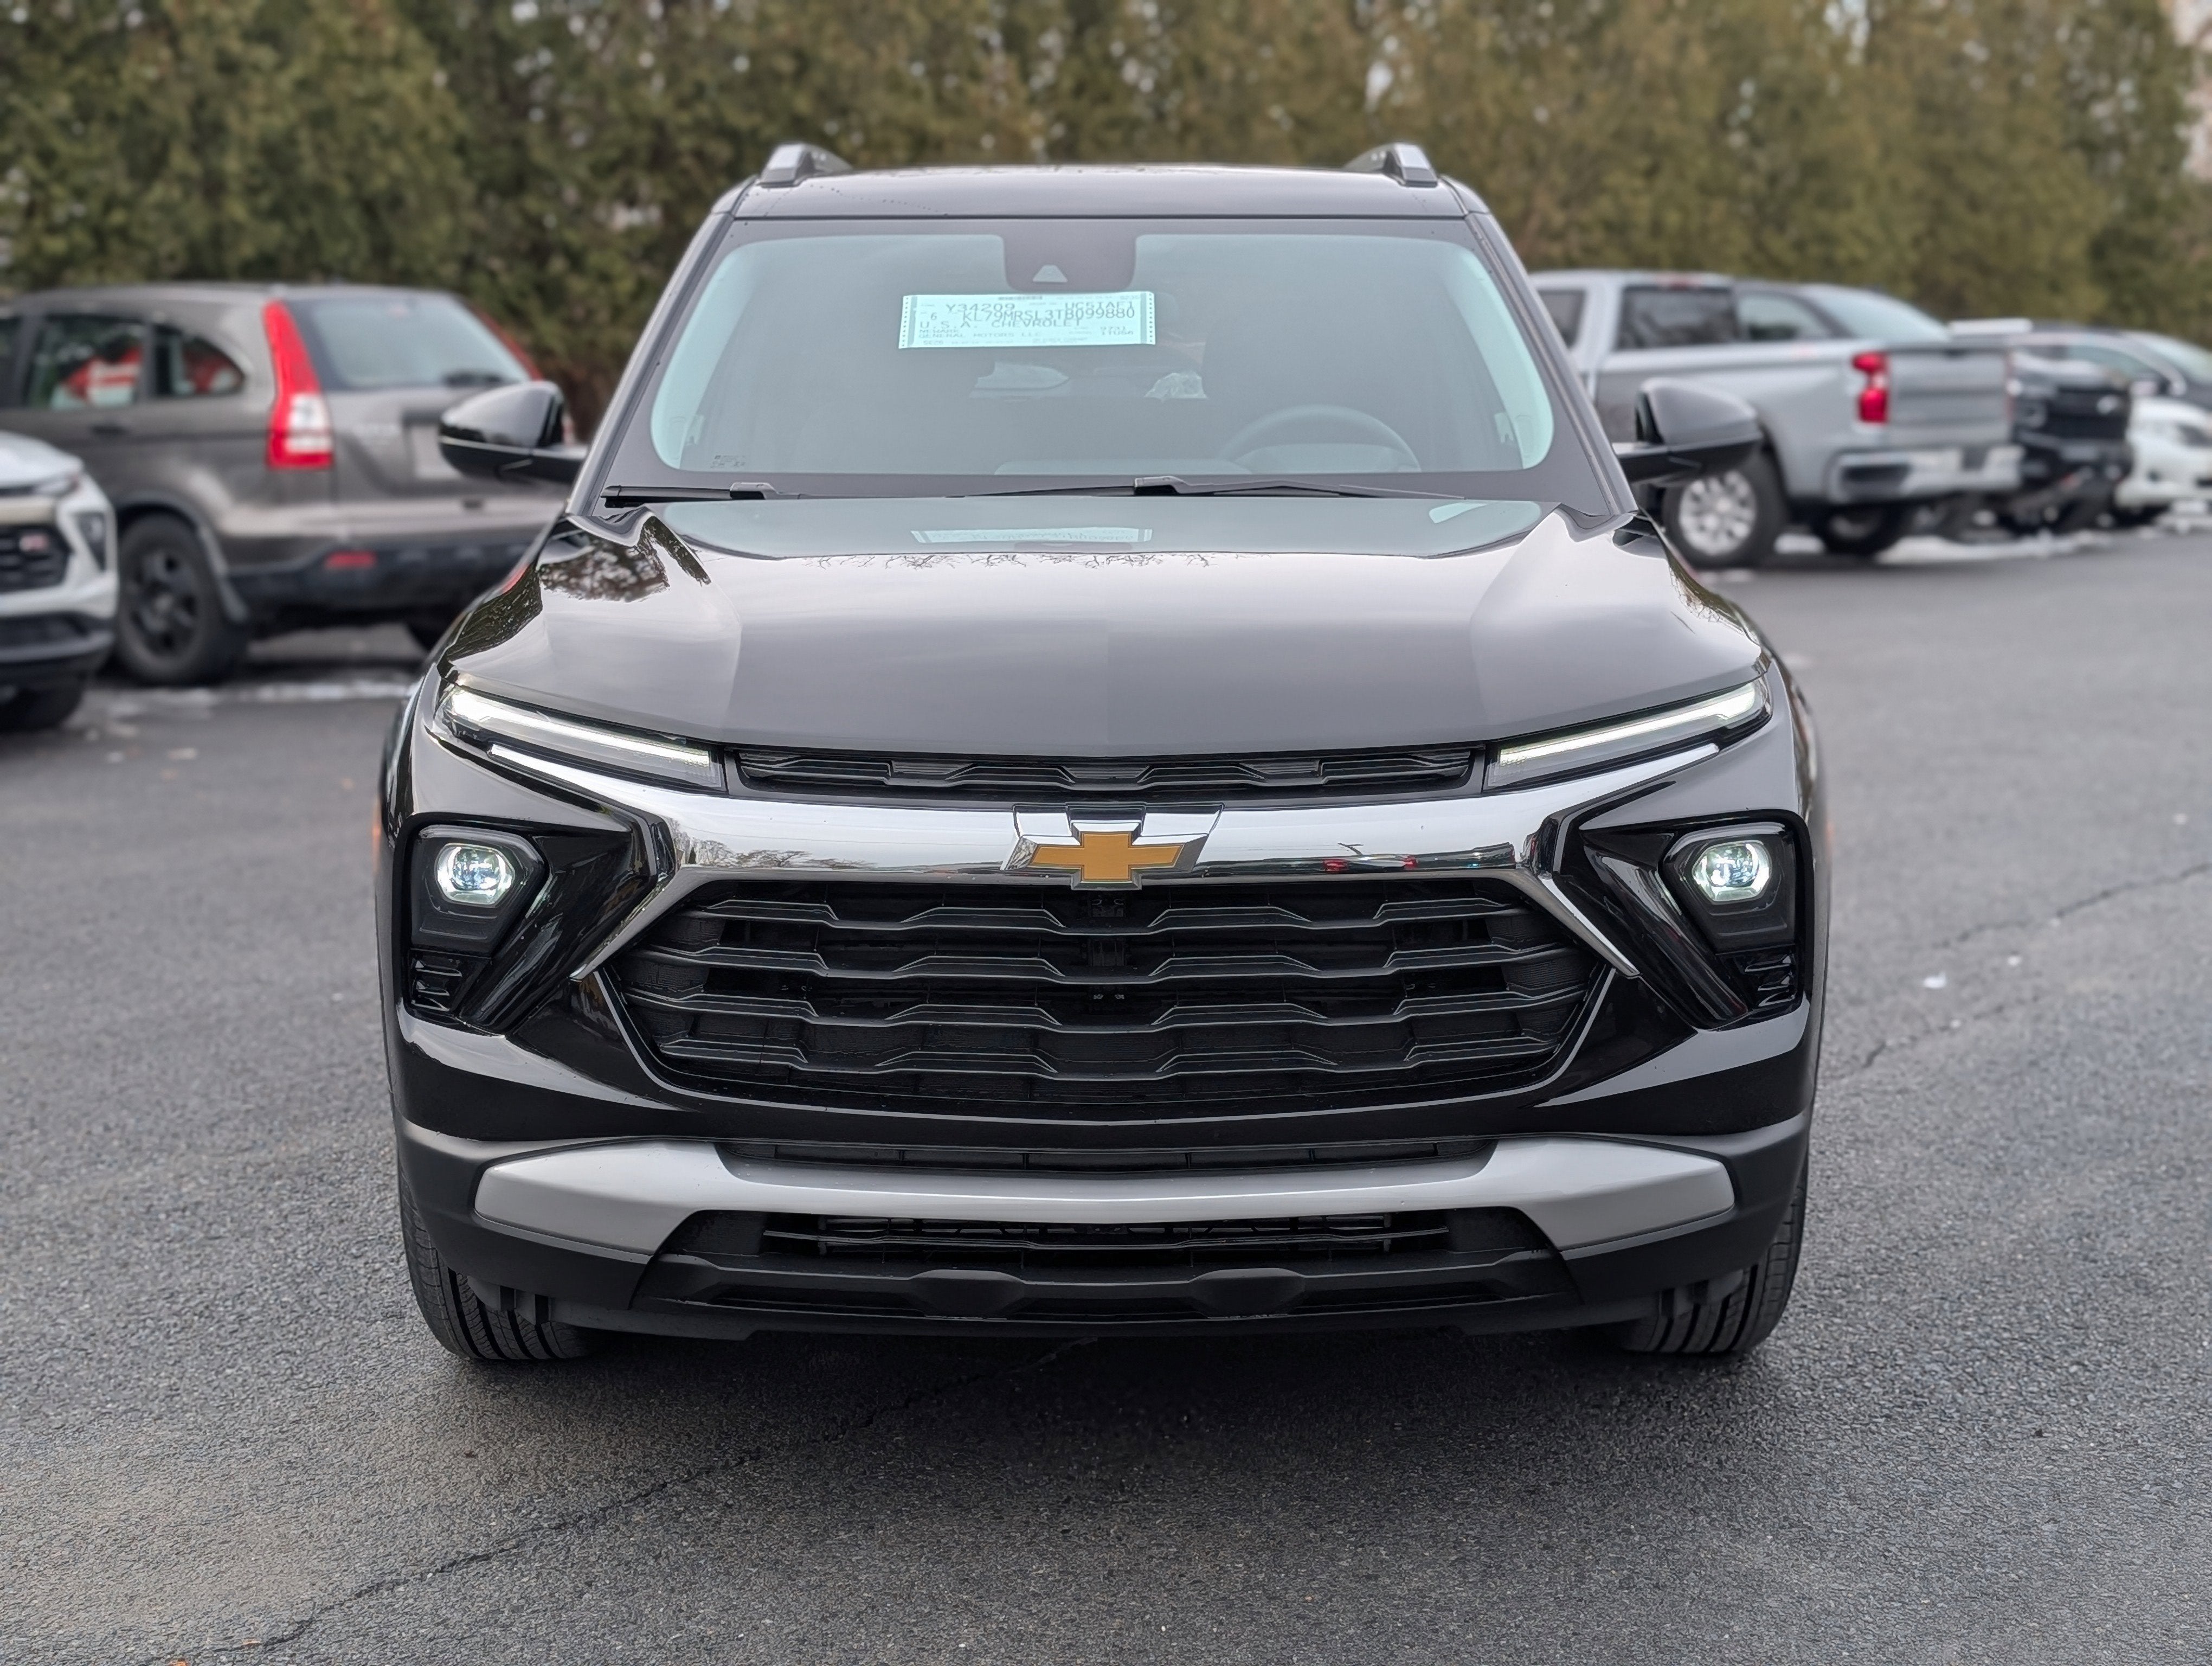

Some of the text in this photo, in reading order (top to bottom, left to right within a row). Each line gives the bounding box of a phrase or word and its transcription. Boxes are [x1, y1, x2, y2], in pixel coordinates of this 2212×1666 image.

[930, 307, 1135, 322] 6 KL79MRSL3TB099880
[991, 318, 1083, 328] CHEVROLET
